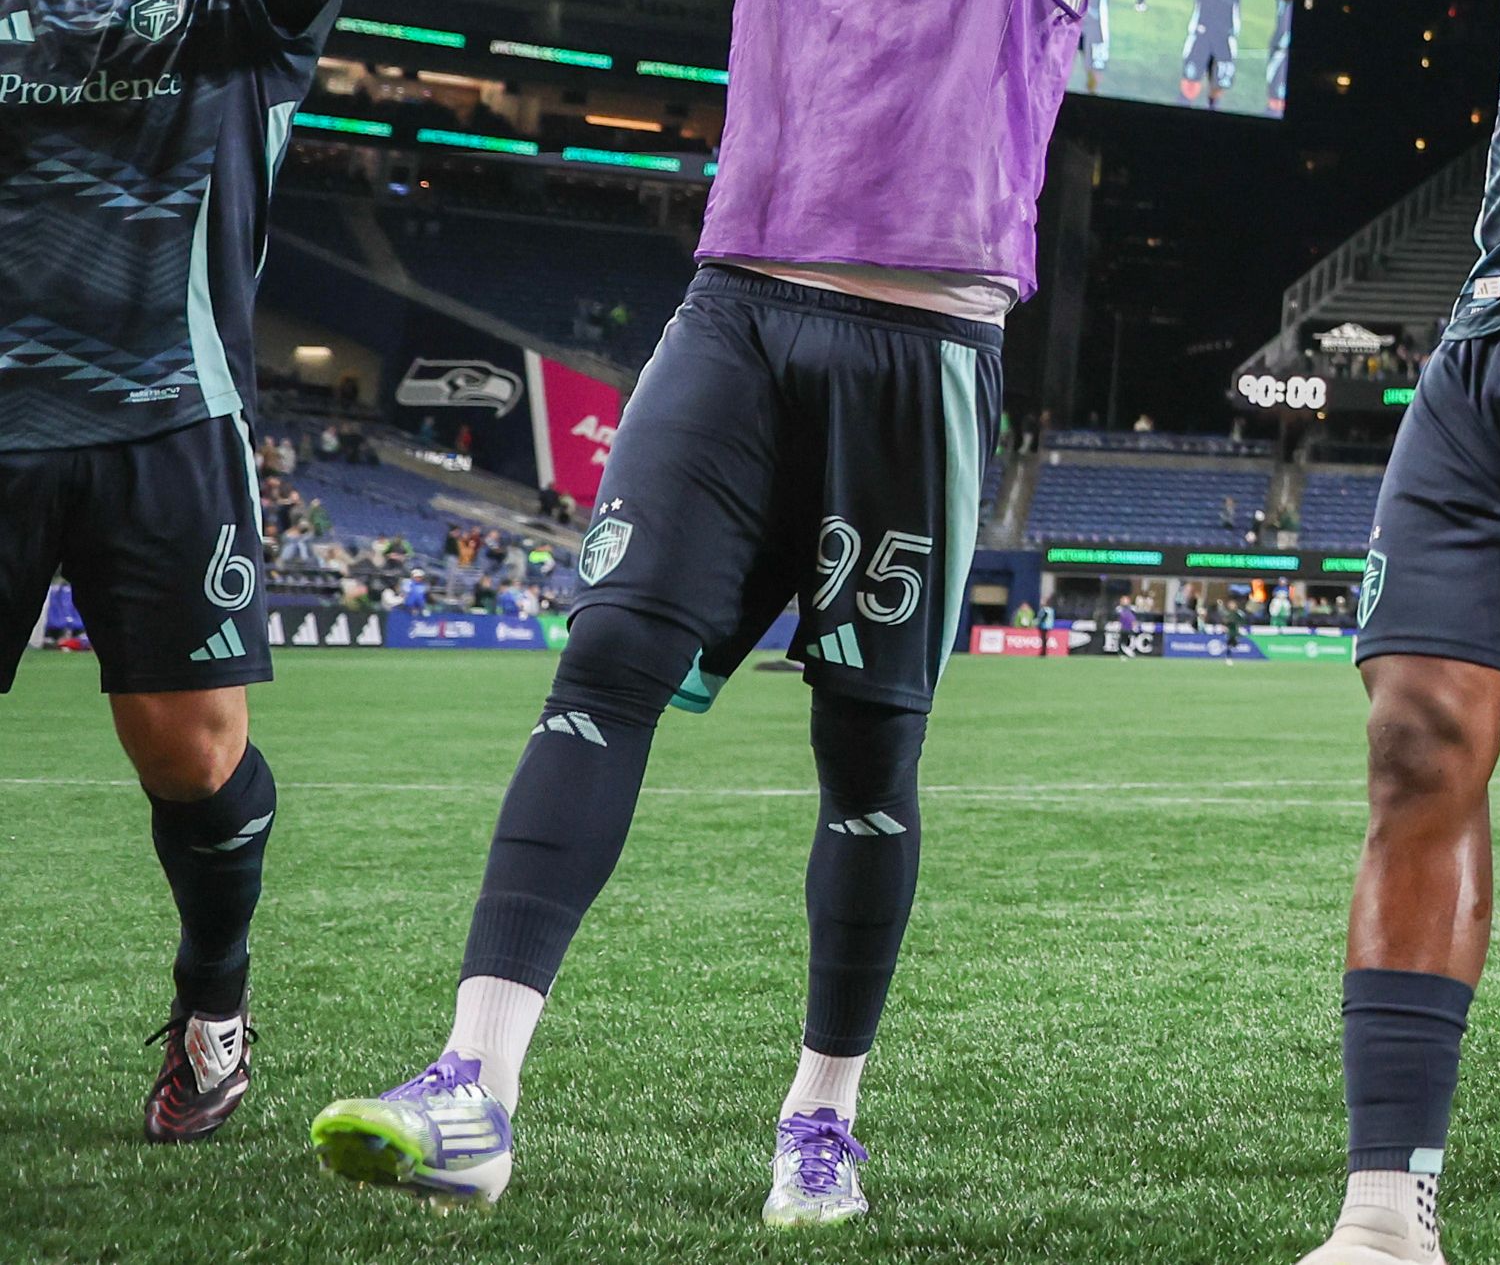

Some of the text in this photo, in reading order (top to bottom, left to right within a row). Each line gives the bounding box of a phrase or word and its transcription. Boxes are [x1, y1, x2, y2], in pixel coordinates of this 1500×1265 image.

[0, 70, 182, 105] Providence
[1238, 375, 1327, 409] 90:00
[204, 524, 256, 612] 6
[811, 515, 933, 626] 95
[1006, 635, 1059, 649] TOYOA
